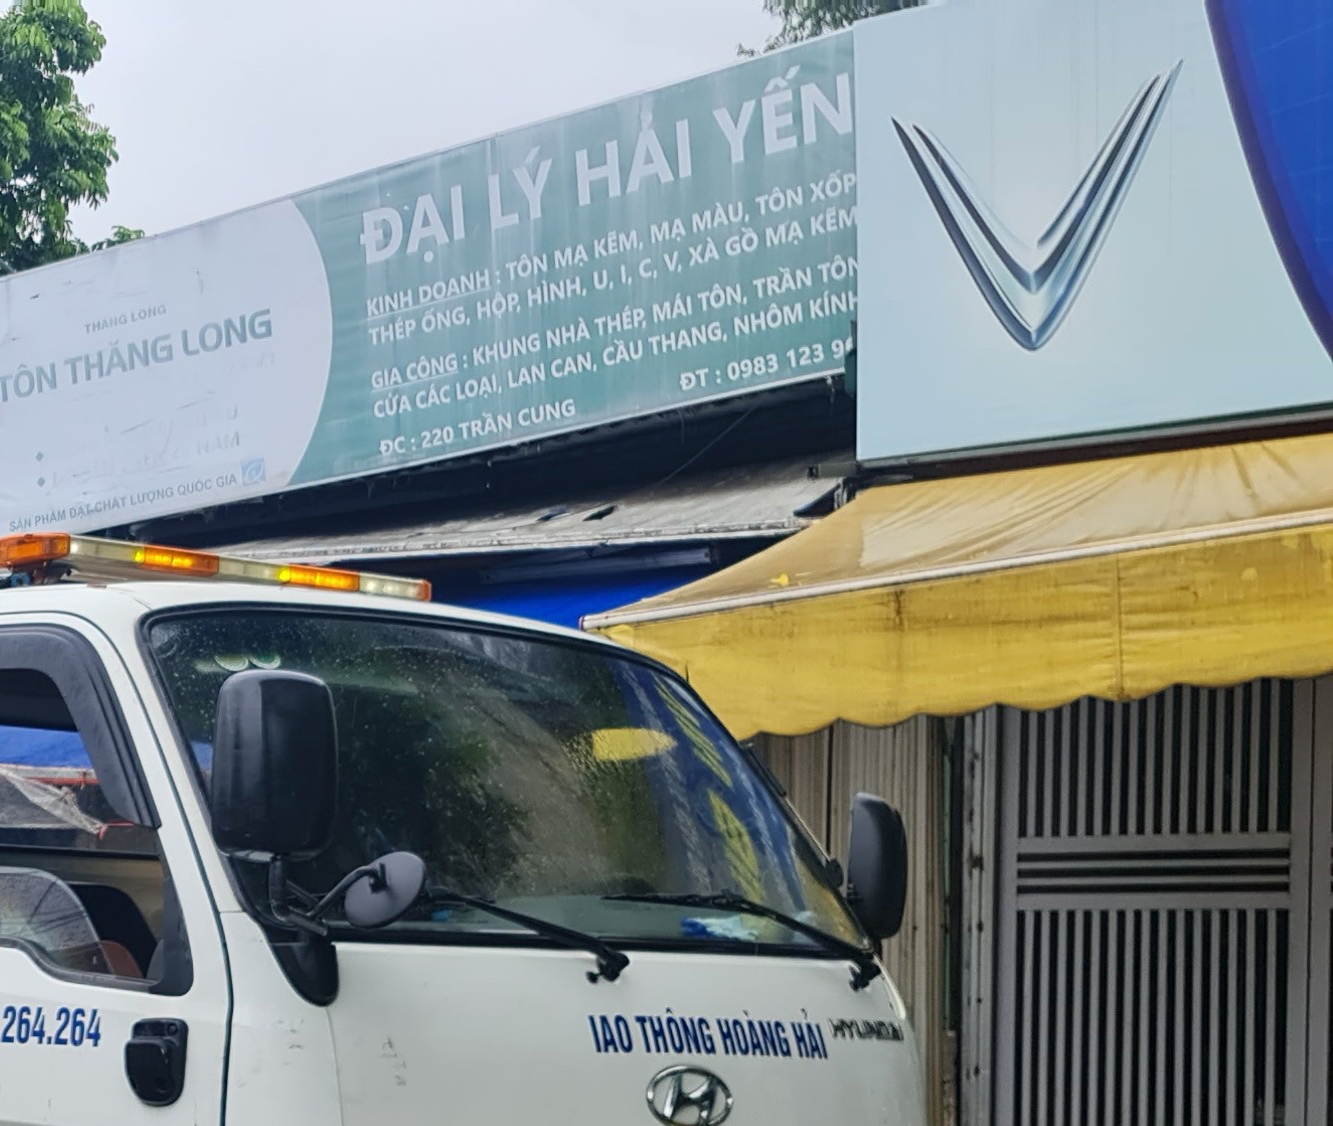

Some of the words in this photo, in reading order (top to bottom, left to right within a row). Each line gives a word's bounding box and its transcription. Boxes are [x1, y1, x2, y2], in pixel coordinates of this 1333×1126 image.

[360, 185, 465, 264] ĐẠI
[488, 147, 554, 231] LÝ
[575, 110, 692, 207] HẢI
[713, 64, 854, 164] YẾN
[366, 289, 413, 318] KINH
[419, 269, 490, 304] DOANH
[505, 253, 548, 281] TÔN
[554, 244, 589, 269] MẠ
[593, 230, 643, 257] KẼM,
[650, 217, 686, 242] MẠ
[691, 201, 750, 232] MÀU,
[755, 186, 804, 216] TÔN
[368, 315, 416, 346] THÉP
[421, 306, 471, 333] ỐNG,
[476, 292, 522, 321] HỘP,
[527, 276, 587, 307] HÌNH,
[592, 268, 614, 290] U,
[638, 258, 658, 280] C,
[663, 250, 682, 273] V,
[689, 236, 720, 266] XÀ
[724, 227, 759, 257] GỒ
[765, 220, 804, 246] MẠ
[810, 205, 857, 237] KẼM
[63, 333, 174, 382] THĂNG
[181, 307, 273, 358] LONG
[130, 304, 167, 323] LONG
[371, 369, 403, 390] GIA
[406, 353, 459, 383] CÔNG
[472, 333, 541, 367] KHUNG
[546, 319, 591, 349] NHÀ
[594, 302, 647, 336] THÉP,
[652, 293, 693, 324] MÁI
[697, 283, 748, 312] TÔN,
[752, 266, 813, 299] TRẦN
[415, 380, 452, 410] CÁC
[455, 374, 503, 400] LOẠI,
[507, 363, 547, 390] LAN
[550, 352, 598, 378] CAN,
[601, 337, 644, 367] CẦU
[648, 322, 728, 356] THANG,
[733, 302, 803, 338] NHÔM
[726, 353, 780, 382] 0983
[786, 342, 826, 369] 123
[421, 426, 455, 449] 220
[459, 411, 513, 441] TRẦN
[517, 398, 577, 427] CUNG
[215, 473, 238, 488] GIA
[635, 1007, 717, 1055] THÔNG
[716, 1009, 793, 1058] HOÀNG
[791, 1007, 829, 1060] HẢI
[828, 1017, 906, 1042] HYUNDAI
